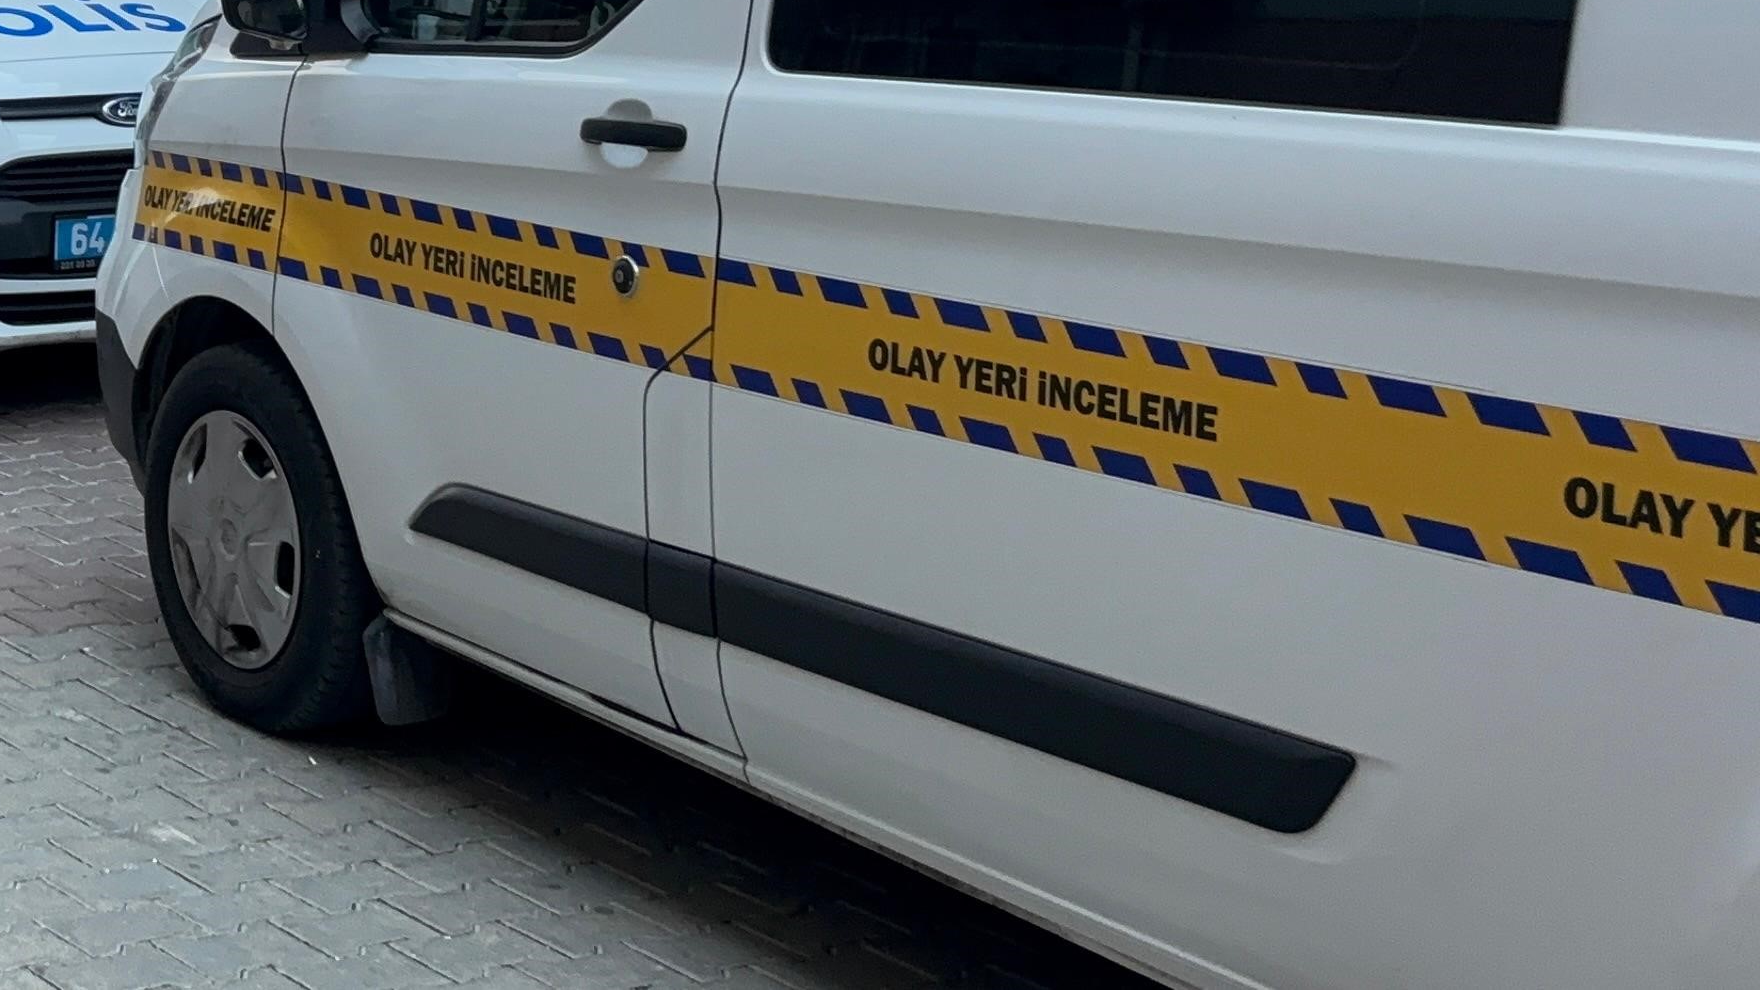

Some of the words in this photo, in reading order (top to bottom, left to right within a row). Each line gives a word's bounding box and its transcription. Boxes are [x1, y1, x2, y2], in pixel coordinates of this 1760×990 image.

[144, 185, 173, 211] OLAY
[172, 190, 197, 215] YER
[71, 221, 106, 256] 64
[370, 232, 418, 267] OLAY
[421, 242, 465, 278] YERİ
[868, 338, 946, 383] OLAY
[953, 354, 1027, 402] YERİ
[1563, 477, 1695, 539] OLAY
